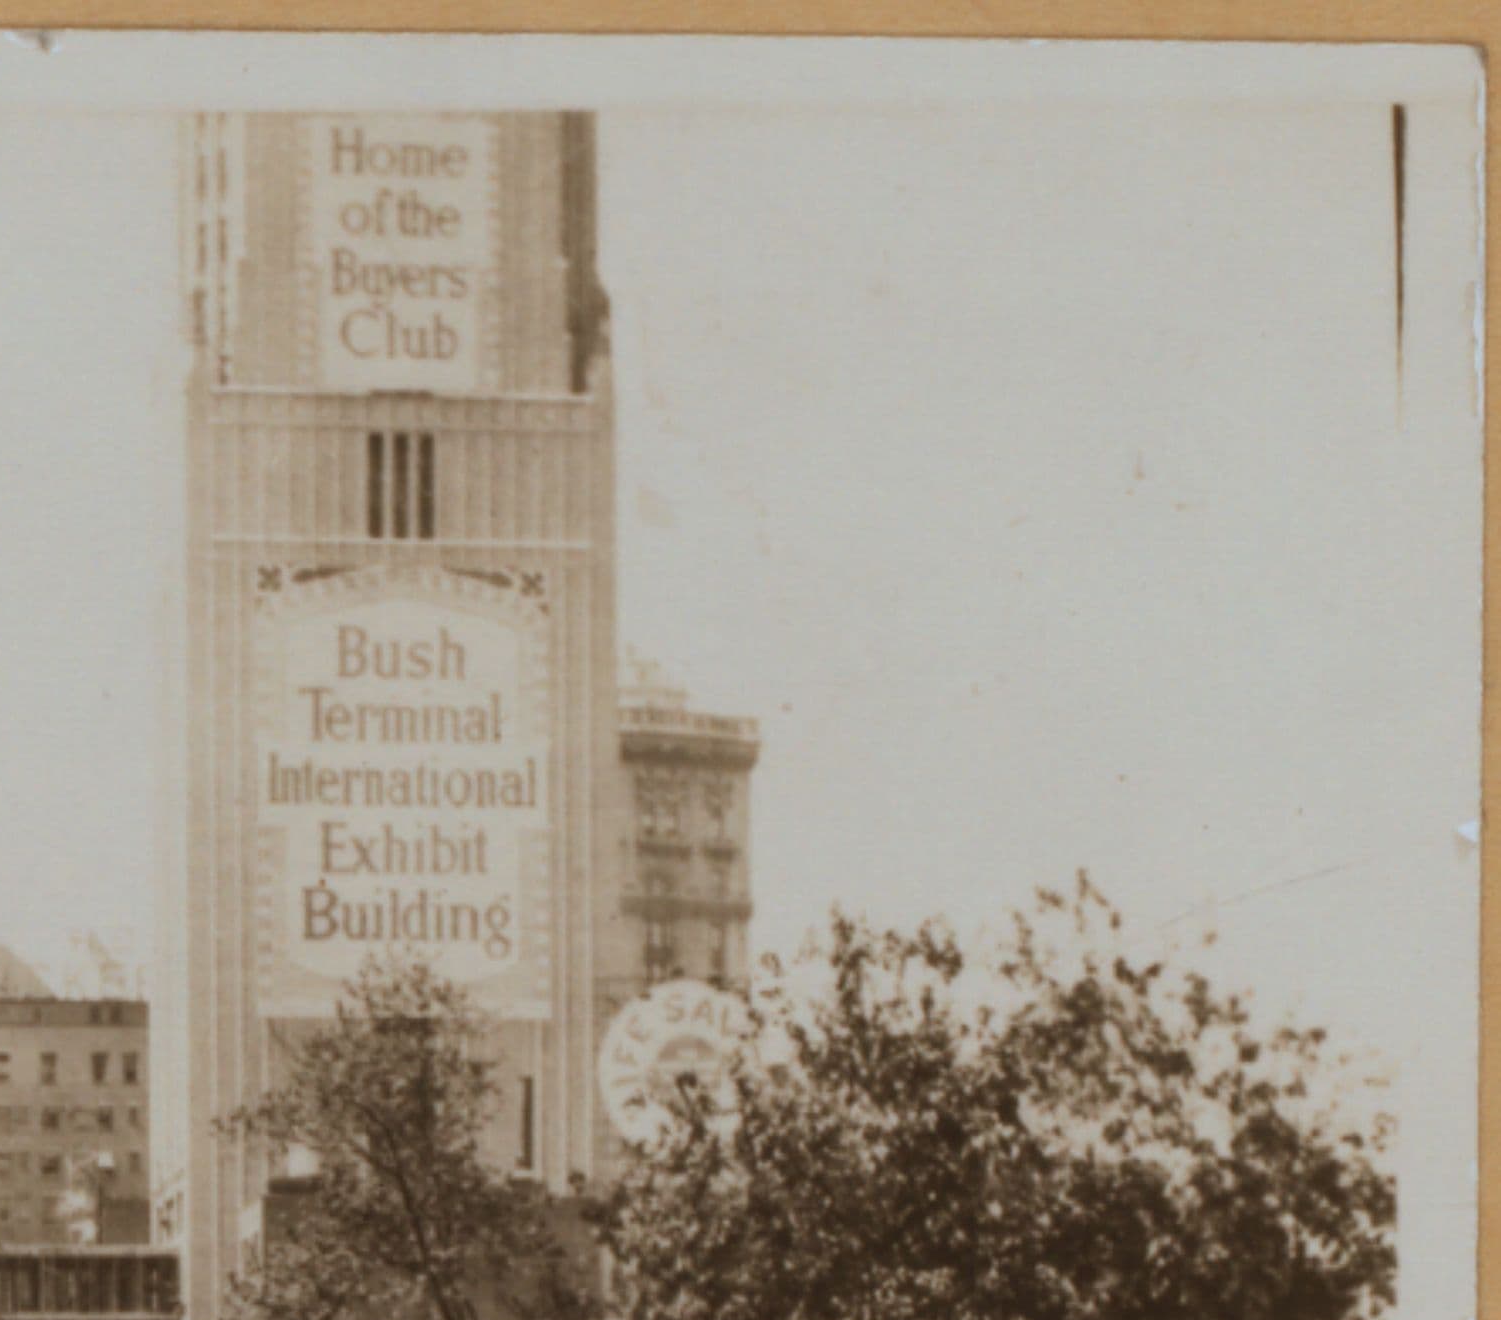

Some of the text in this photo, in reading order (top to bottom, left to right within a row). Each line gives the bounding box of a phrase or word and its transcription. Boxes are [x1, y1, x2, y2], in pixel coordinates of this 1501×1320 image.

[330, 126, 468, 177] Home
[339, 187, 461, 238] of the
[331, 247, 469, 306] Buyers
[339, 308, 458, 361] Club
[336, 624, 466, 681] Bush
[299, 686, 504, 744] Terminal
[267, 751, 537, 809] International
[319, 820, 490, 876] Exhibit
[302, 885, 513, 960] Building
